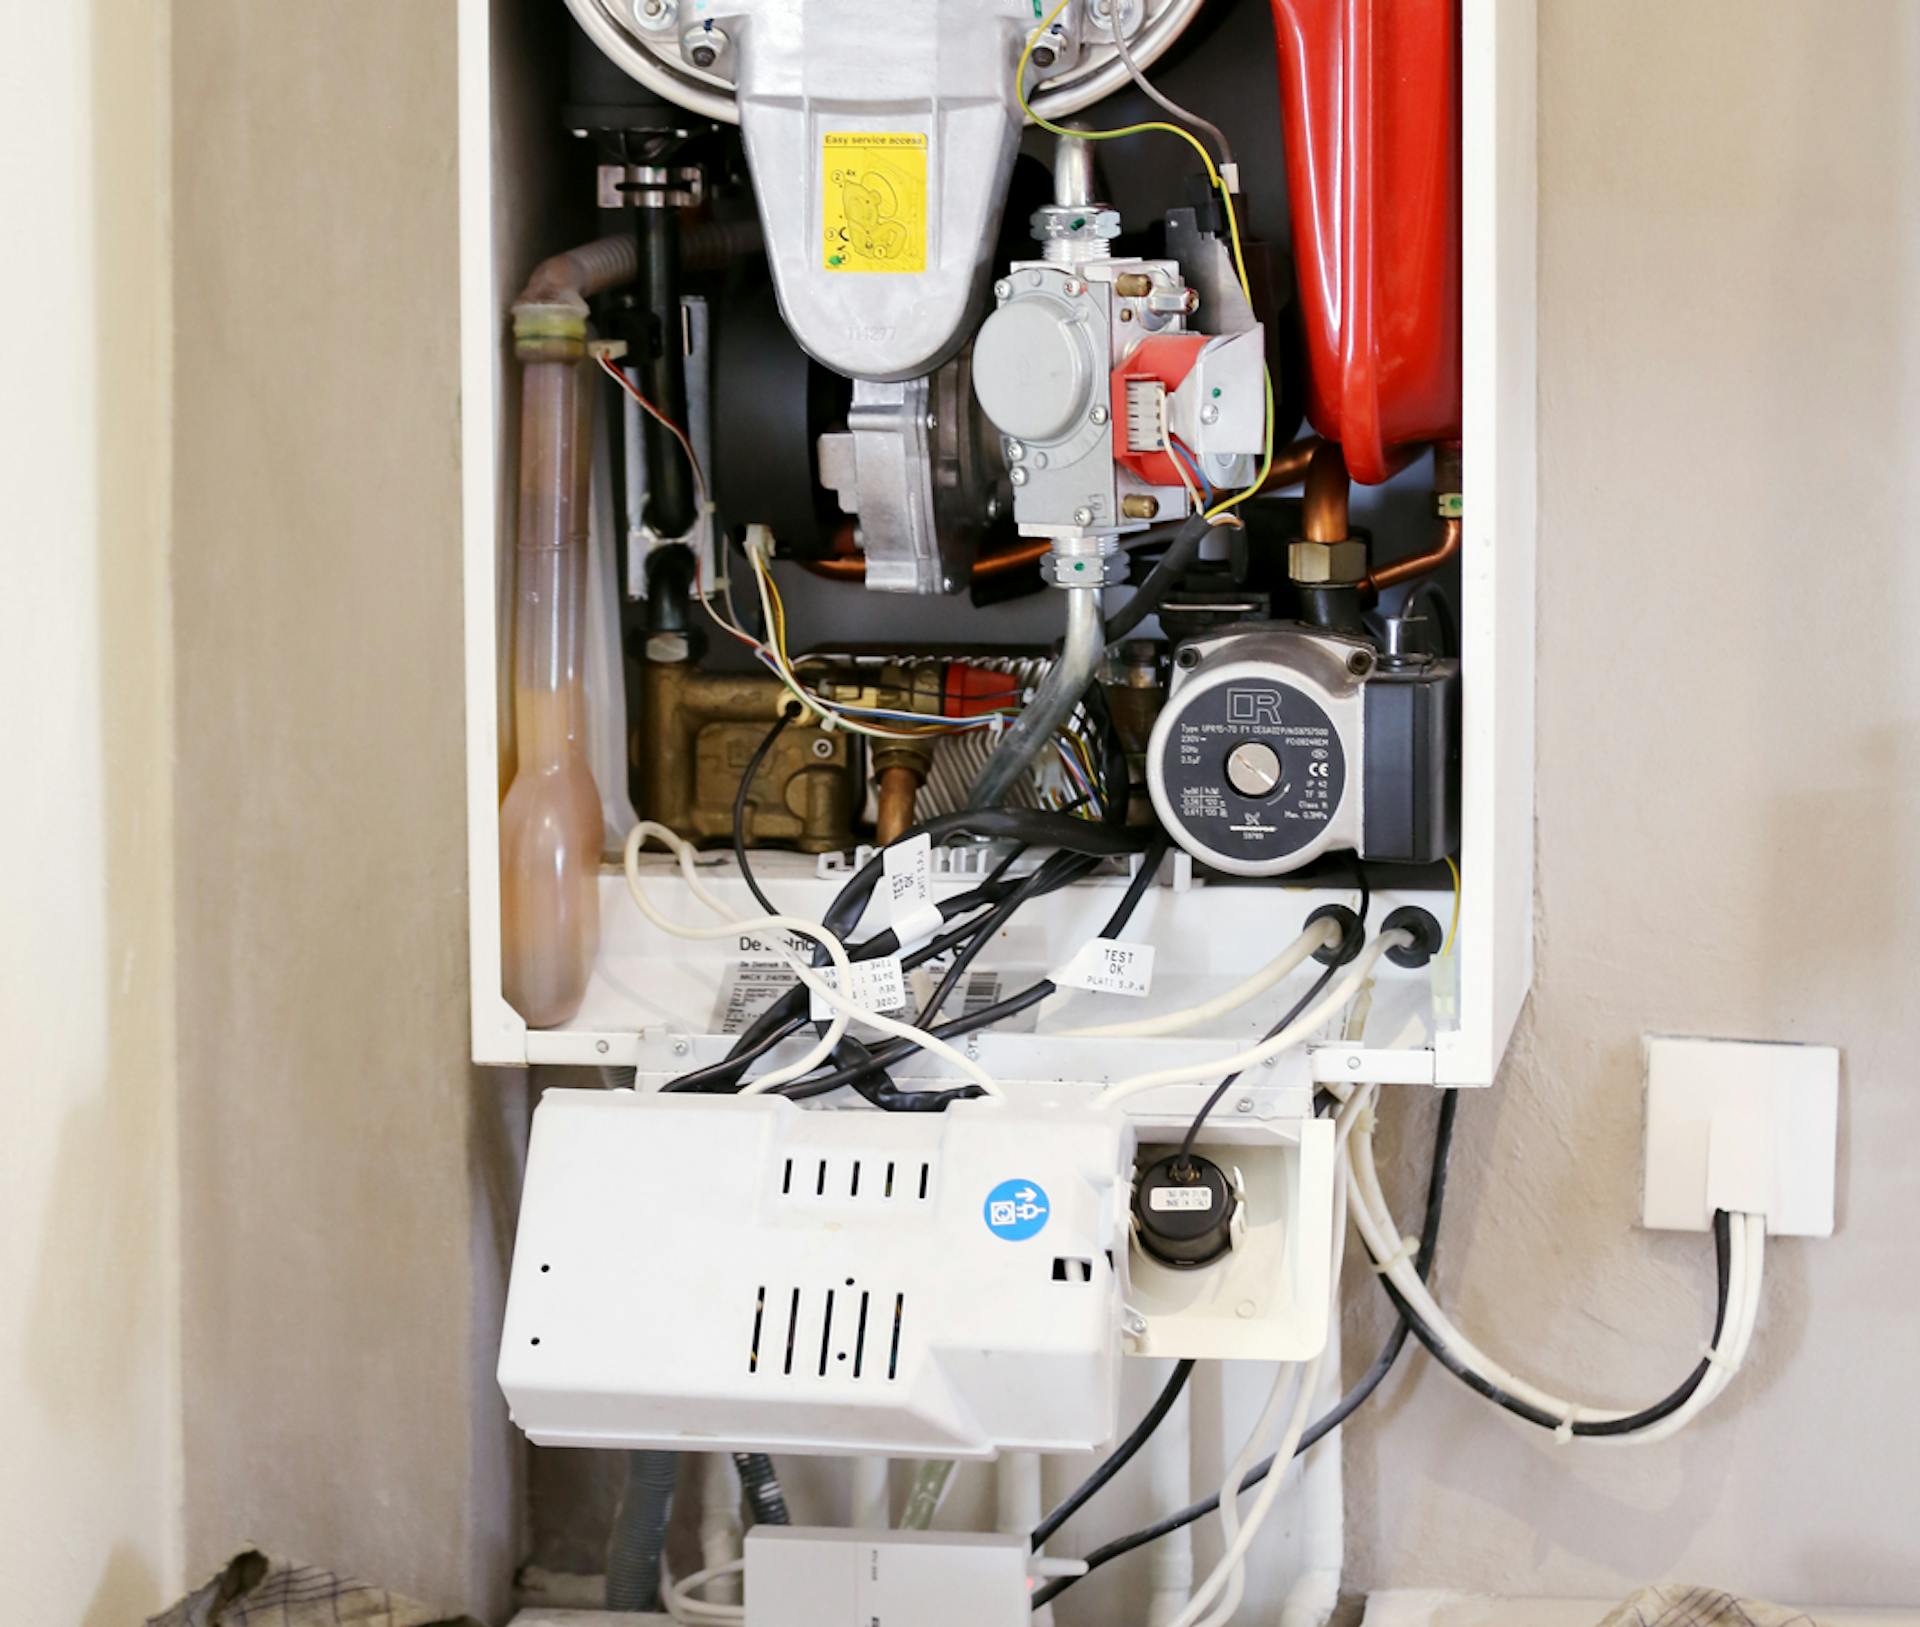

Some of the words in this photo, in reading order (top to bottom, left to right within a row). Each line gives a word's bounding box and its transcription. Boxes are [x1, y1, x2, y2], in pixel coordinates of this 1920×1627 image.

[825, 136, 848, 144] Easy
[851, 136, 886, 144] service
[888, 136, 922, 144] access
[1308, 762, 1328, 776] CE
[892, 872, 904, 900] TEST
[740, 936, 762, 951] De
[1104, 948, 1134, 964] TEST
[870, 960, 892, 969] TIME
[1109, 963, 1124, 976] OK
[872, 972, 894, 982] DATE
[879, 984, 896, 994] REV
[876, 996, 898, 1008] CODE
